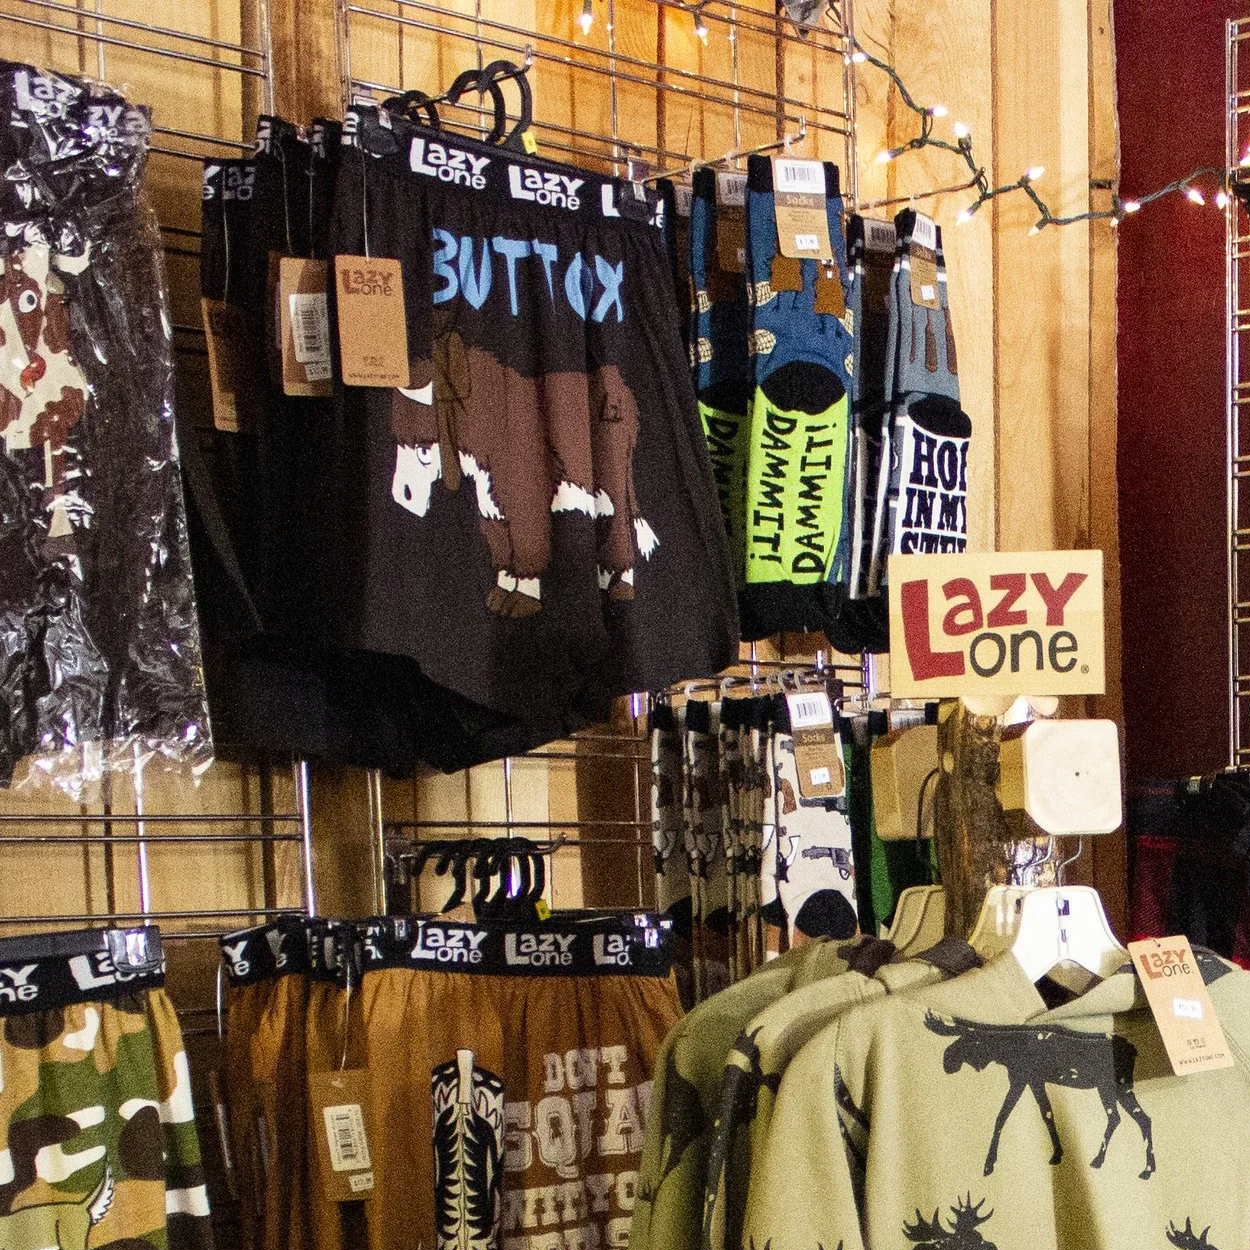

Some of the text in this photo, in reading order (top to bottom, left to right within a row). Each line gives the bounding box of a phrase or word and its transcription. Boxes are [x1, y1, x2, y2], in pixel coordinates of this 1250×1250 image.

[437, 165, 487, 191] one
[535, 189, 580, 211] one
[432, 226, 625, 324] BUTTOX
[361, 283, 393, 296] one
[750, 407, 798, 564] DAMMIT!
[791, 422, 837, 574] DAMMIT!
[901, 487, 936, 530] IN
[436, 944, 484, 964] one
[529, 948, 574, 967] one
[1162, 963, 1191, 977] one
